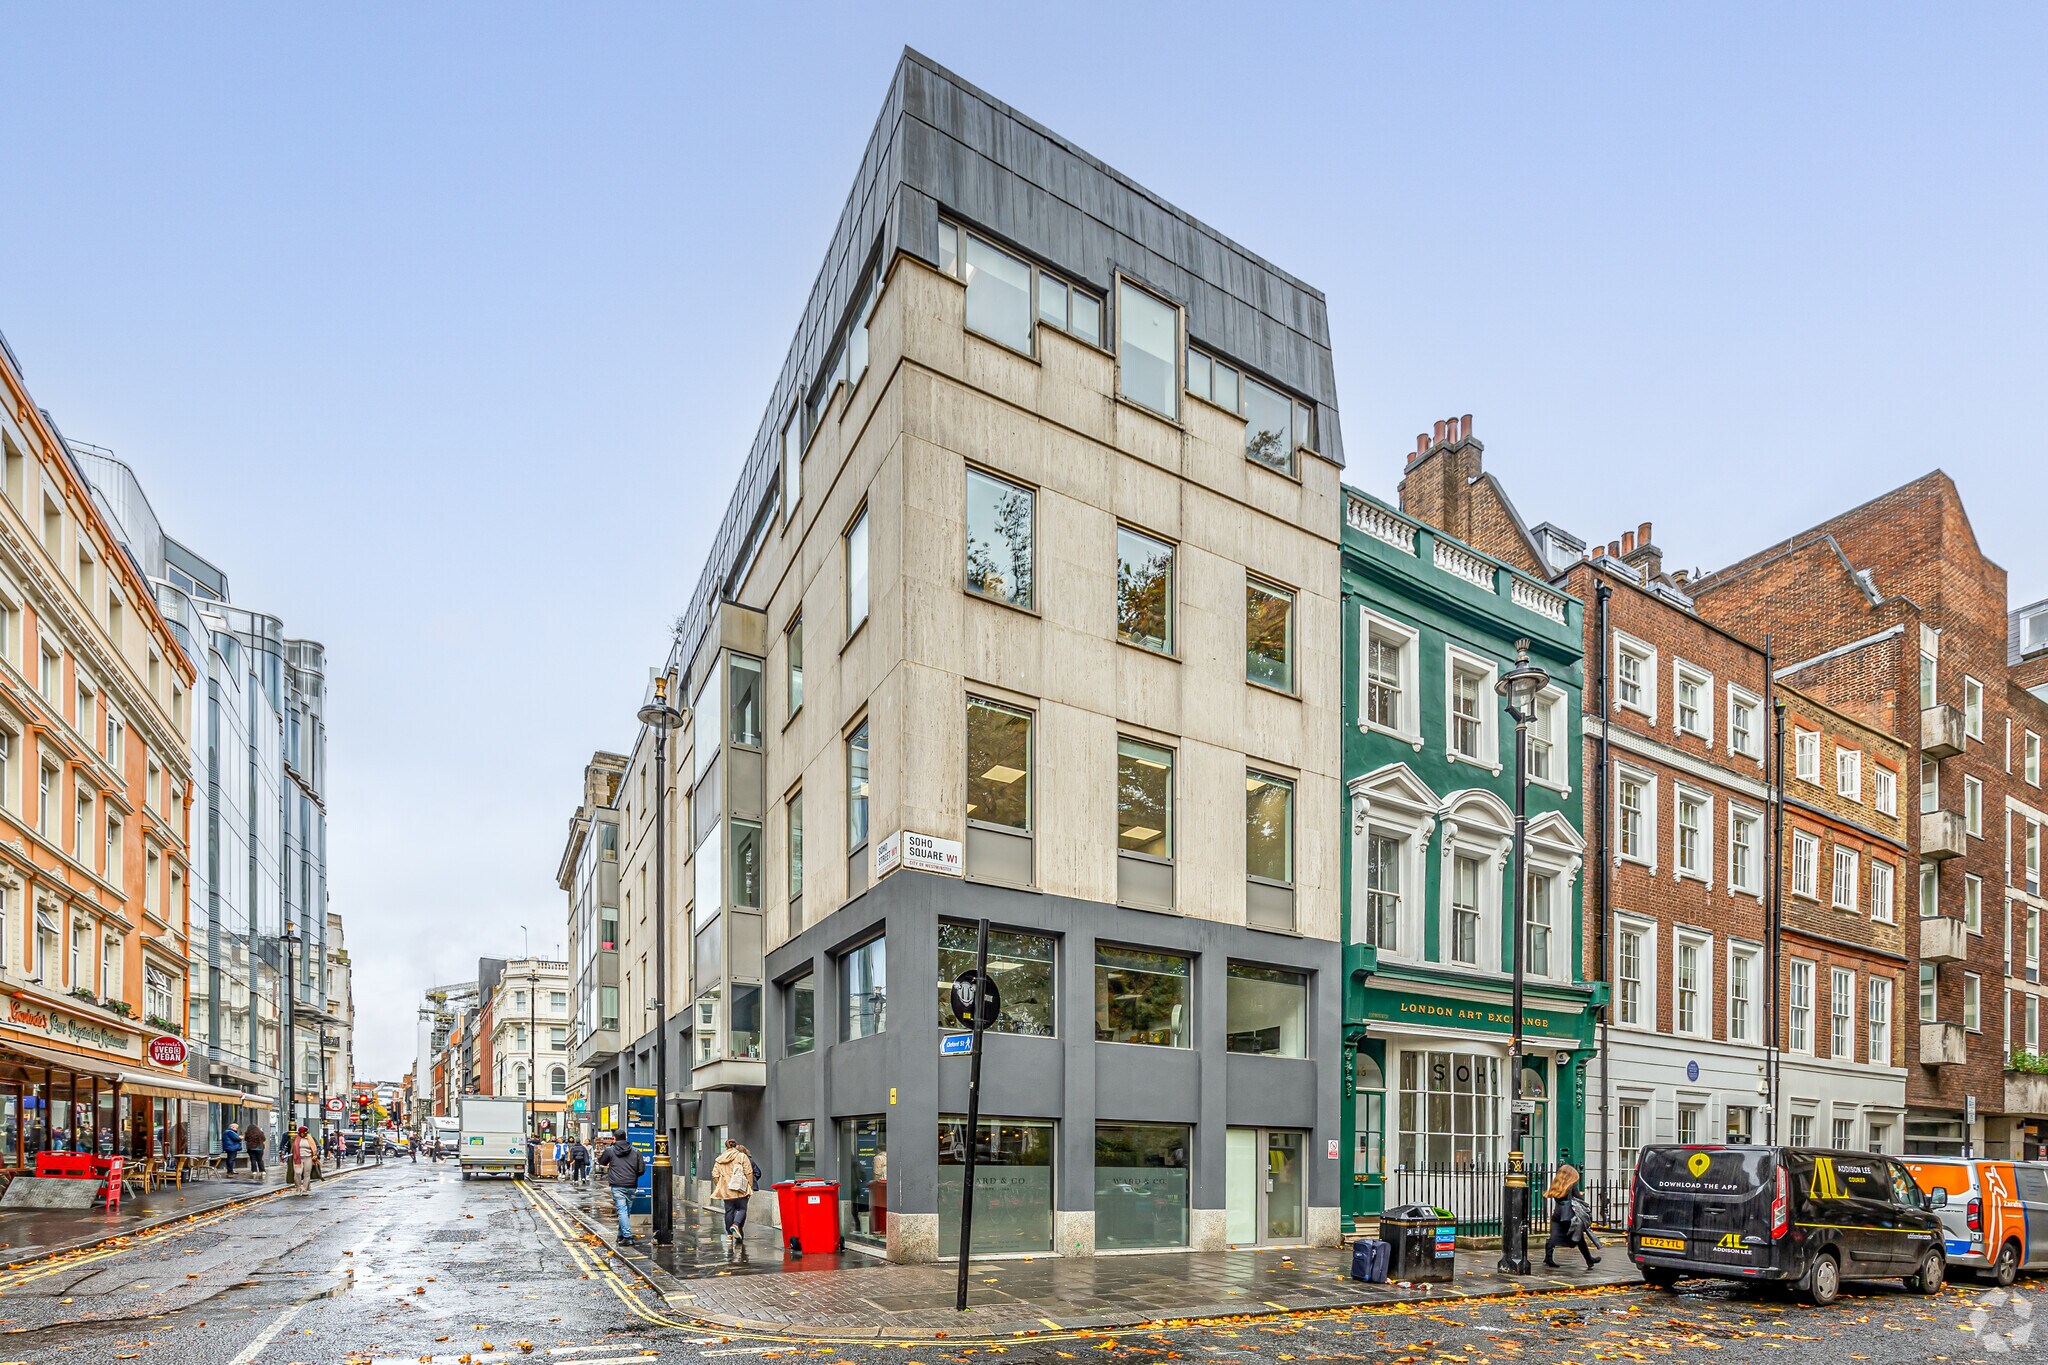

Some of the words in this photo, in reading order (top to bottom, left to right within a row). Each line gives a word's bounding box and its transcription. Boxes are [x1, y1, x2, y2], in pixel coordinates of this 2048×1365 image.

[878, 842, 888, 856] SOHO
[910, 836, 932, 848] SOHO
[878, 850, 890, 866] STREET
[910, 847, 944, 861] SQUARE
[946, 854, 958, 864] W1
[925, 863, 952, 872] WESTMINSTER
[1401, 1003, 1453, 1017] LONDON
[1458, 1010, 1482, 1020] ART
[155, 1053, 180, 1061] VEGAN
[1434, 1064, 1497, 1084] SOHO
[1838, 1166, 1861, 1174] ADDISON
